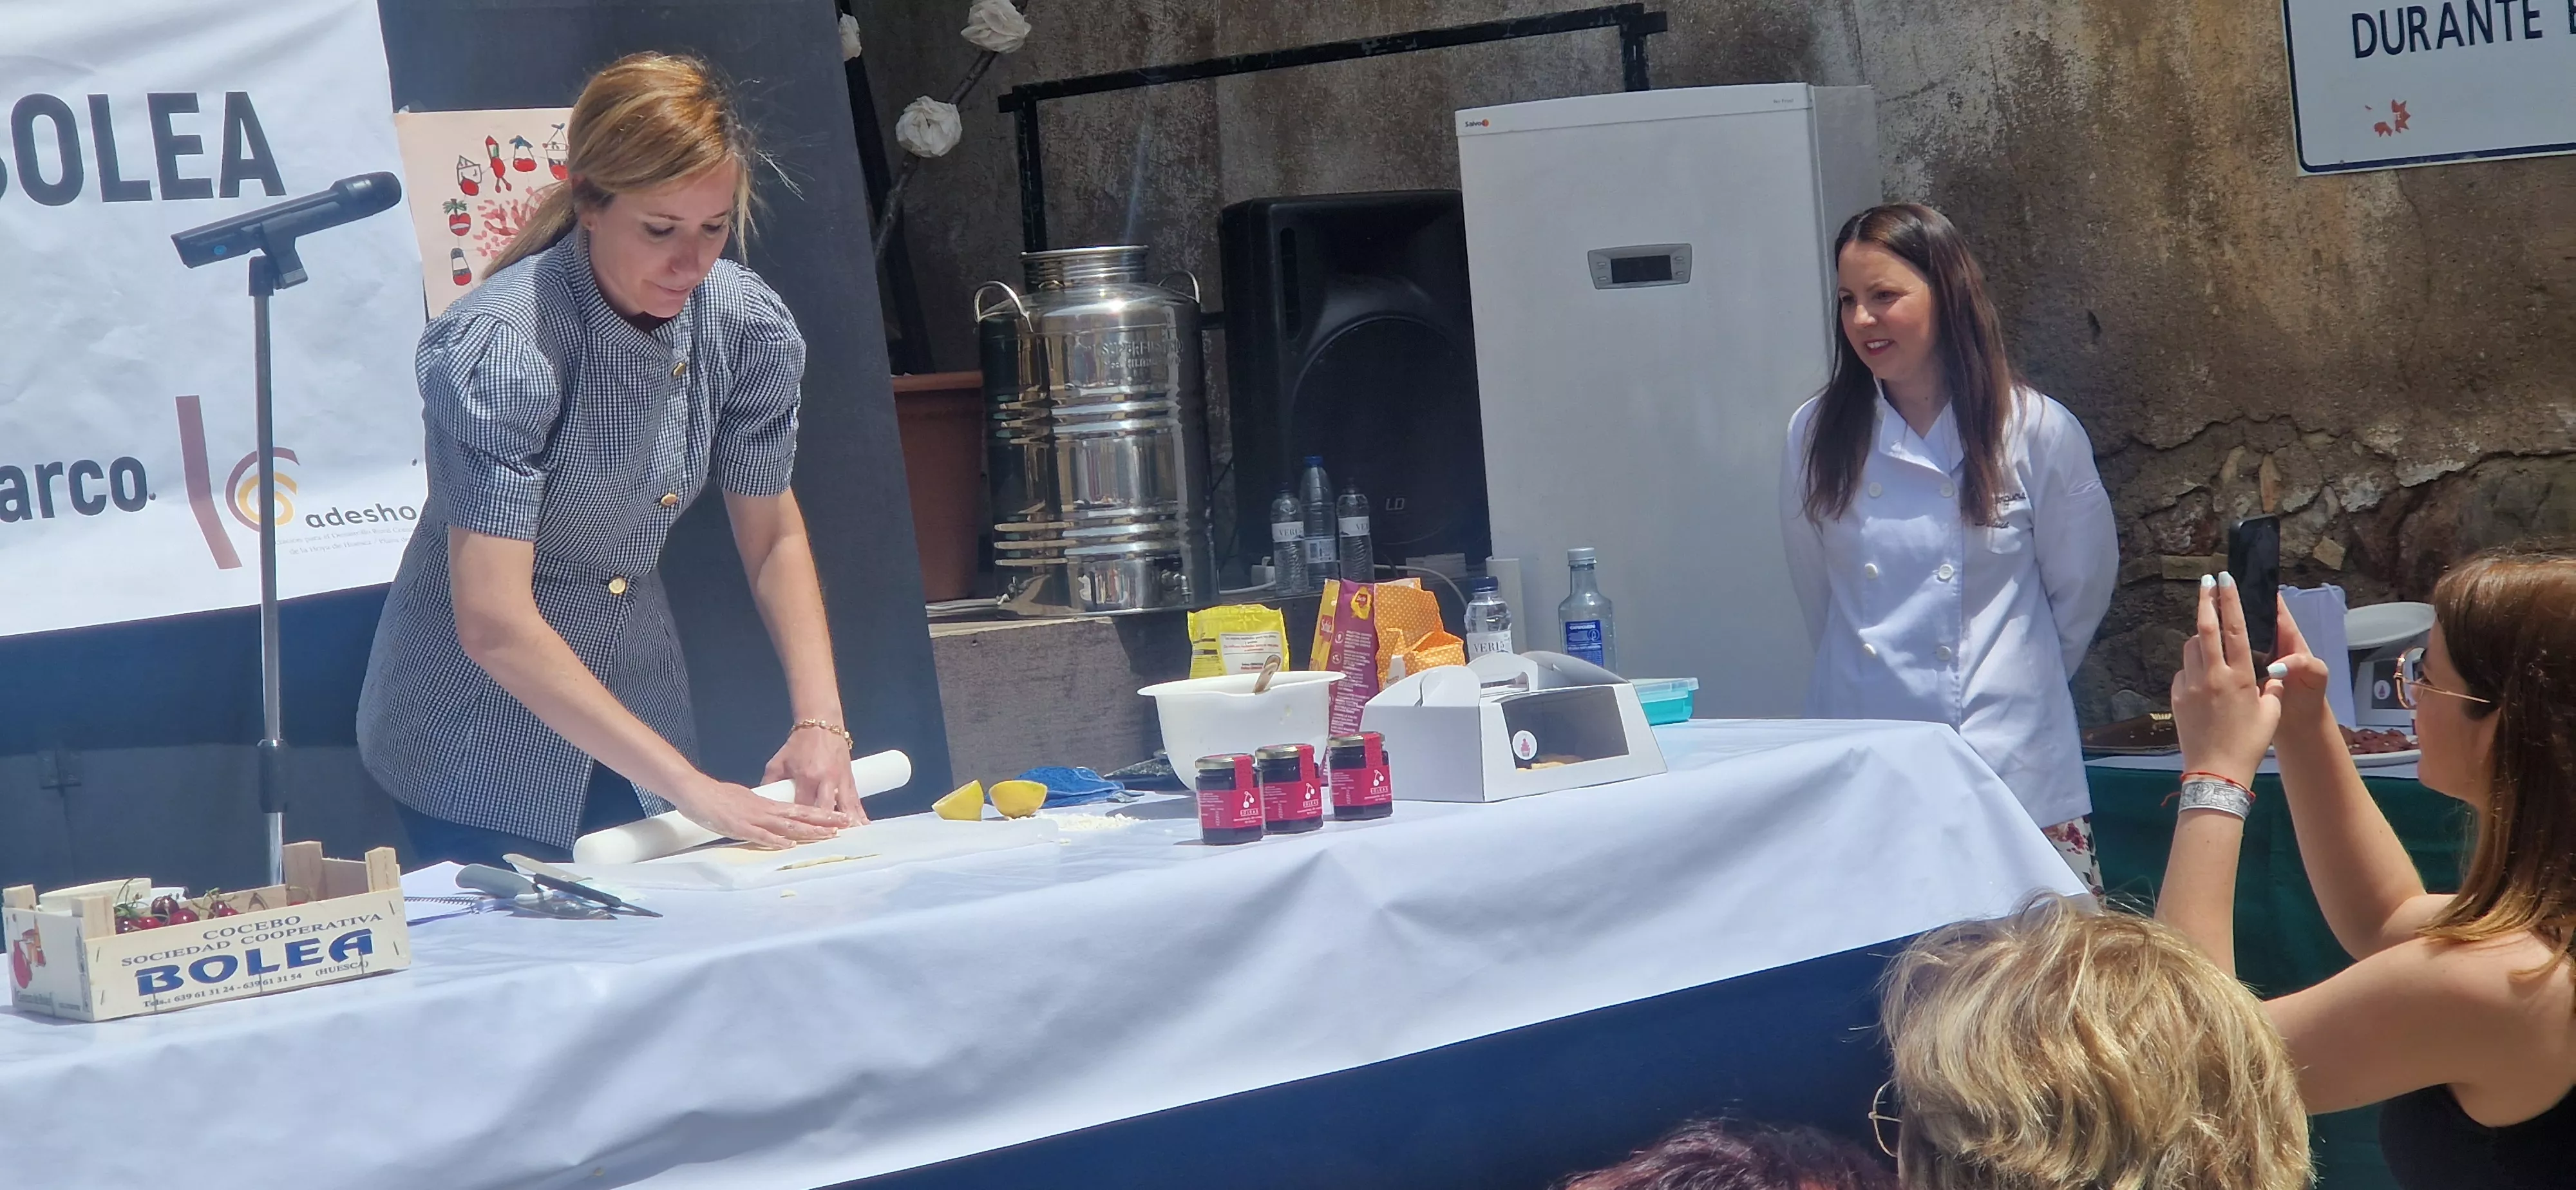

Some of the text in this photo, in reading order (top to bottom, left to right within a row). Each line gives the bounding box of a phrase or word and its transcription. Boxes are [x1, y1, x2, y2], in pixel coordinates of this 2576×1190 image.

[2352, 0, 2543, 59] DURANTE
[0, 91, 287, 206] OLEA
[305, 503, 417, 528] adesho
[1386, 497, 1405, 511] LD
[122, 913, 383, 967] SOCIEDAD COOPERATIVA
[202, 916, 301, 940] COCEBO
[134, 928, 374, 997] BOLEA
[174, 994, 192, 1002] 639
[209, 987, 220, 996] 31
[223, 985, 234, 993] 24
[263, 977, 274, 985] 61
[276, 974, 287, 983] 31
[290, 972, 302, 981] 54
[315, 960, 369, 977] (HUESCA)
